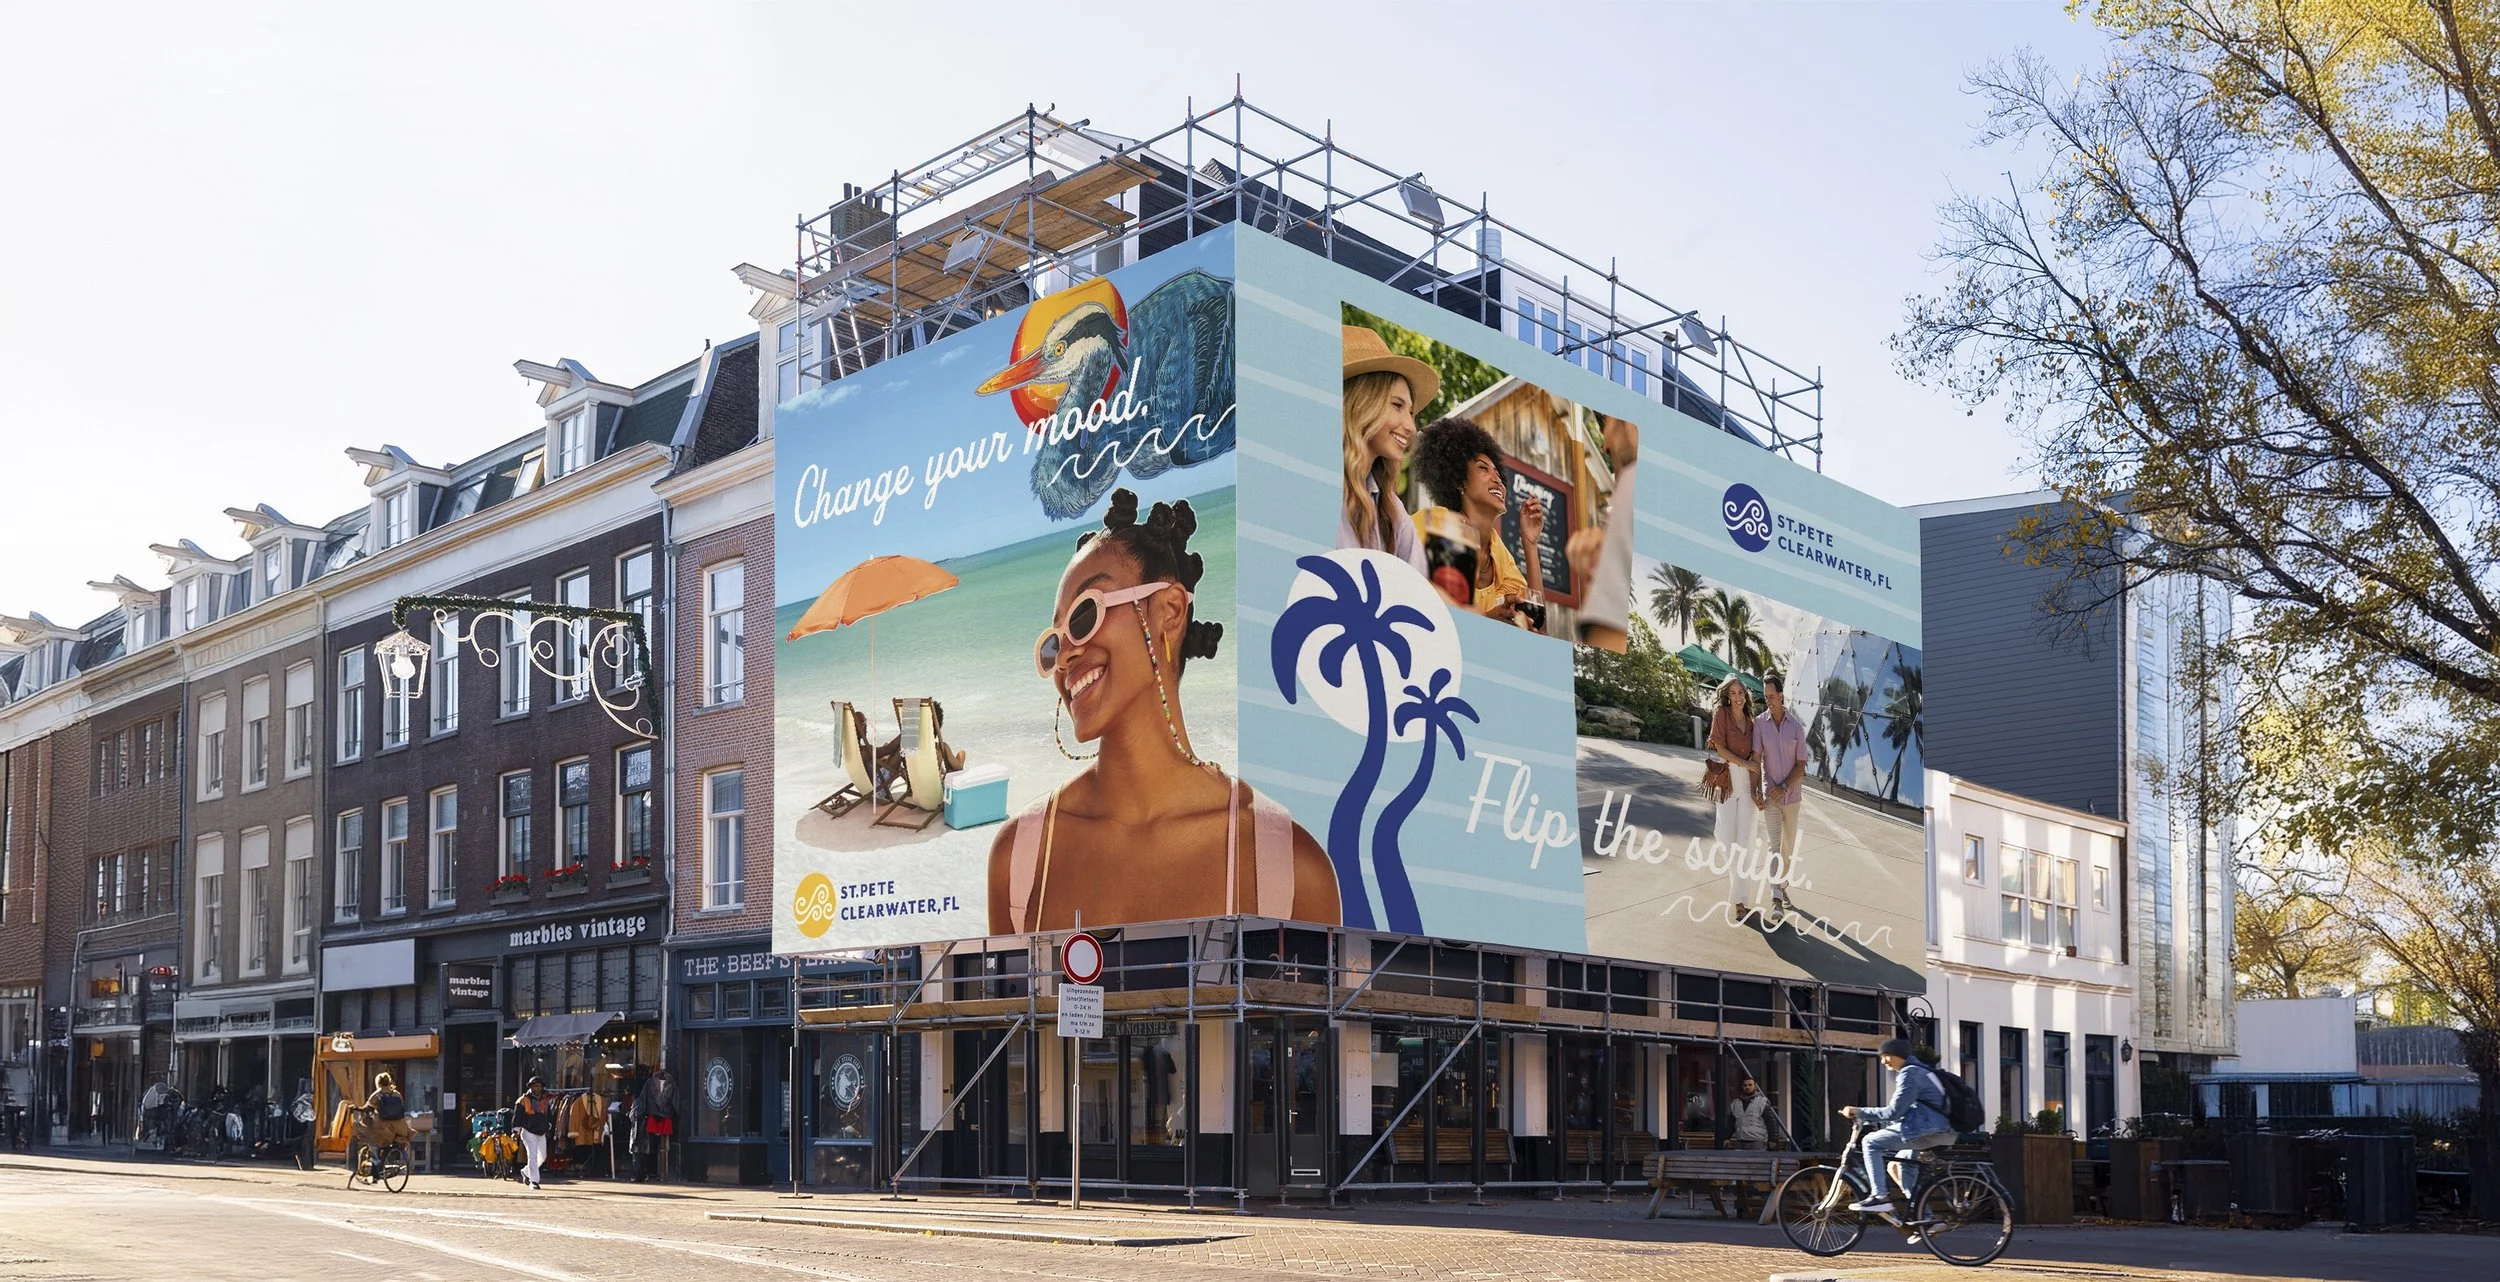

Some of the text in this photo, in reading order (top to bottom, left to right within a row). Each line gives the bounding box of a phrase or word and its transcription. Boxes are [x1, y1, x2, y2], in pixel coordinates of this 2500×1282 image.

[793, 356, 1149, 528] Change your mood.
[1777, 514, 1834, 548] ST.PETE
[1465, 751, 1813, 903] Flip the script.
[840, 880, 895, 899] ST.PETE
[509, 916, 646, 947] marbles vintage
[449, 976, 490, 986] marbles
[450, 987, 489, 998] vintage
[1115, 1021, 1172, 1036] KNGFISHER
